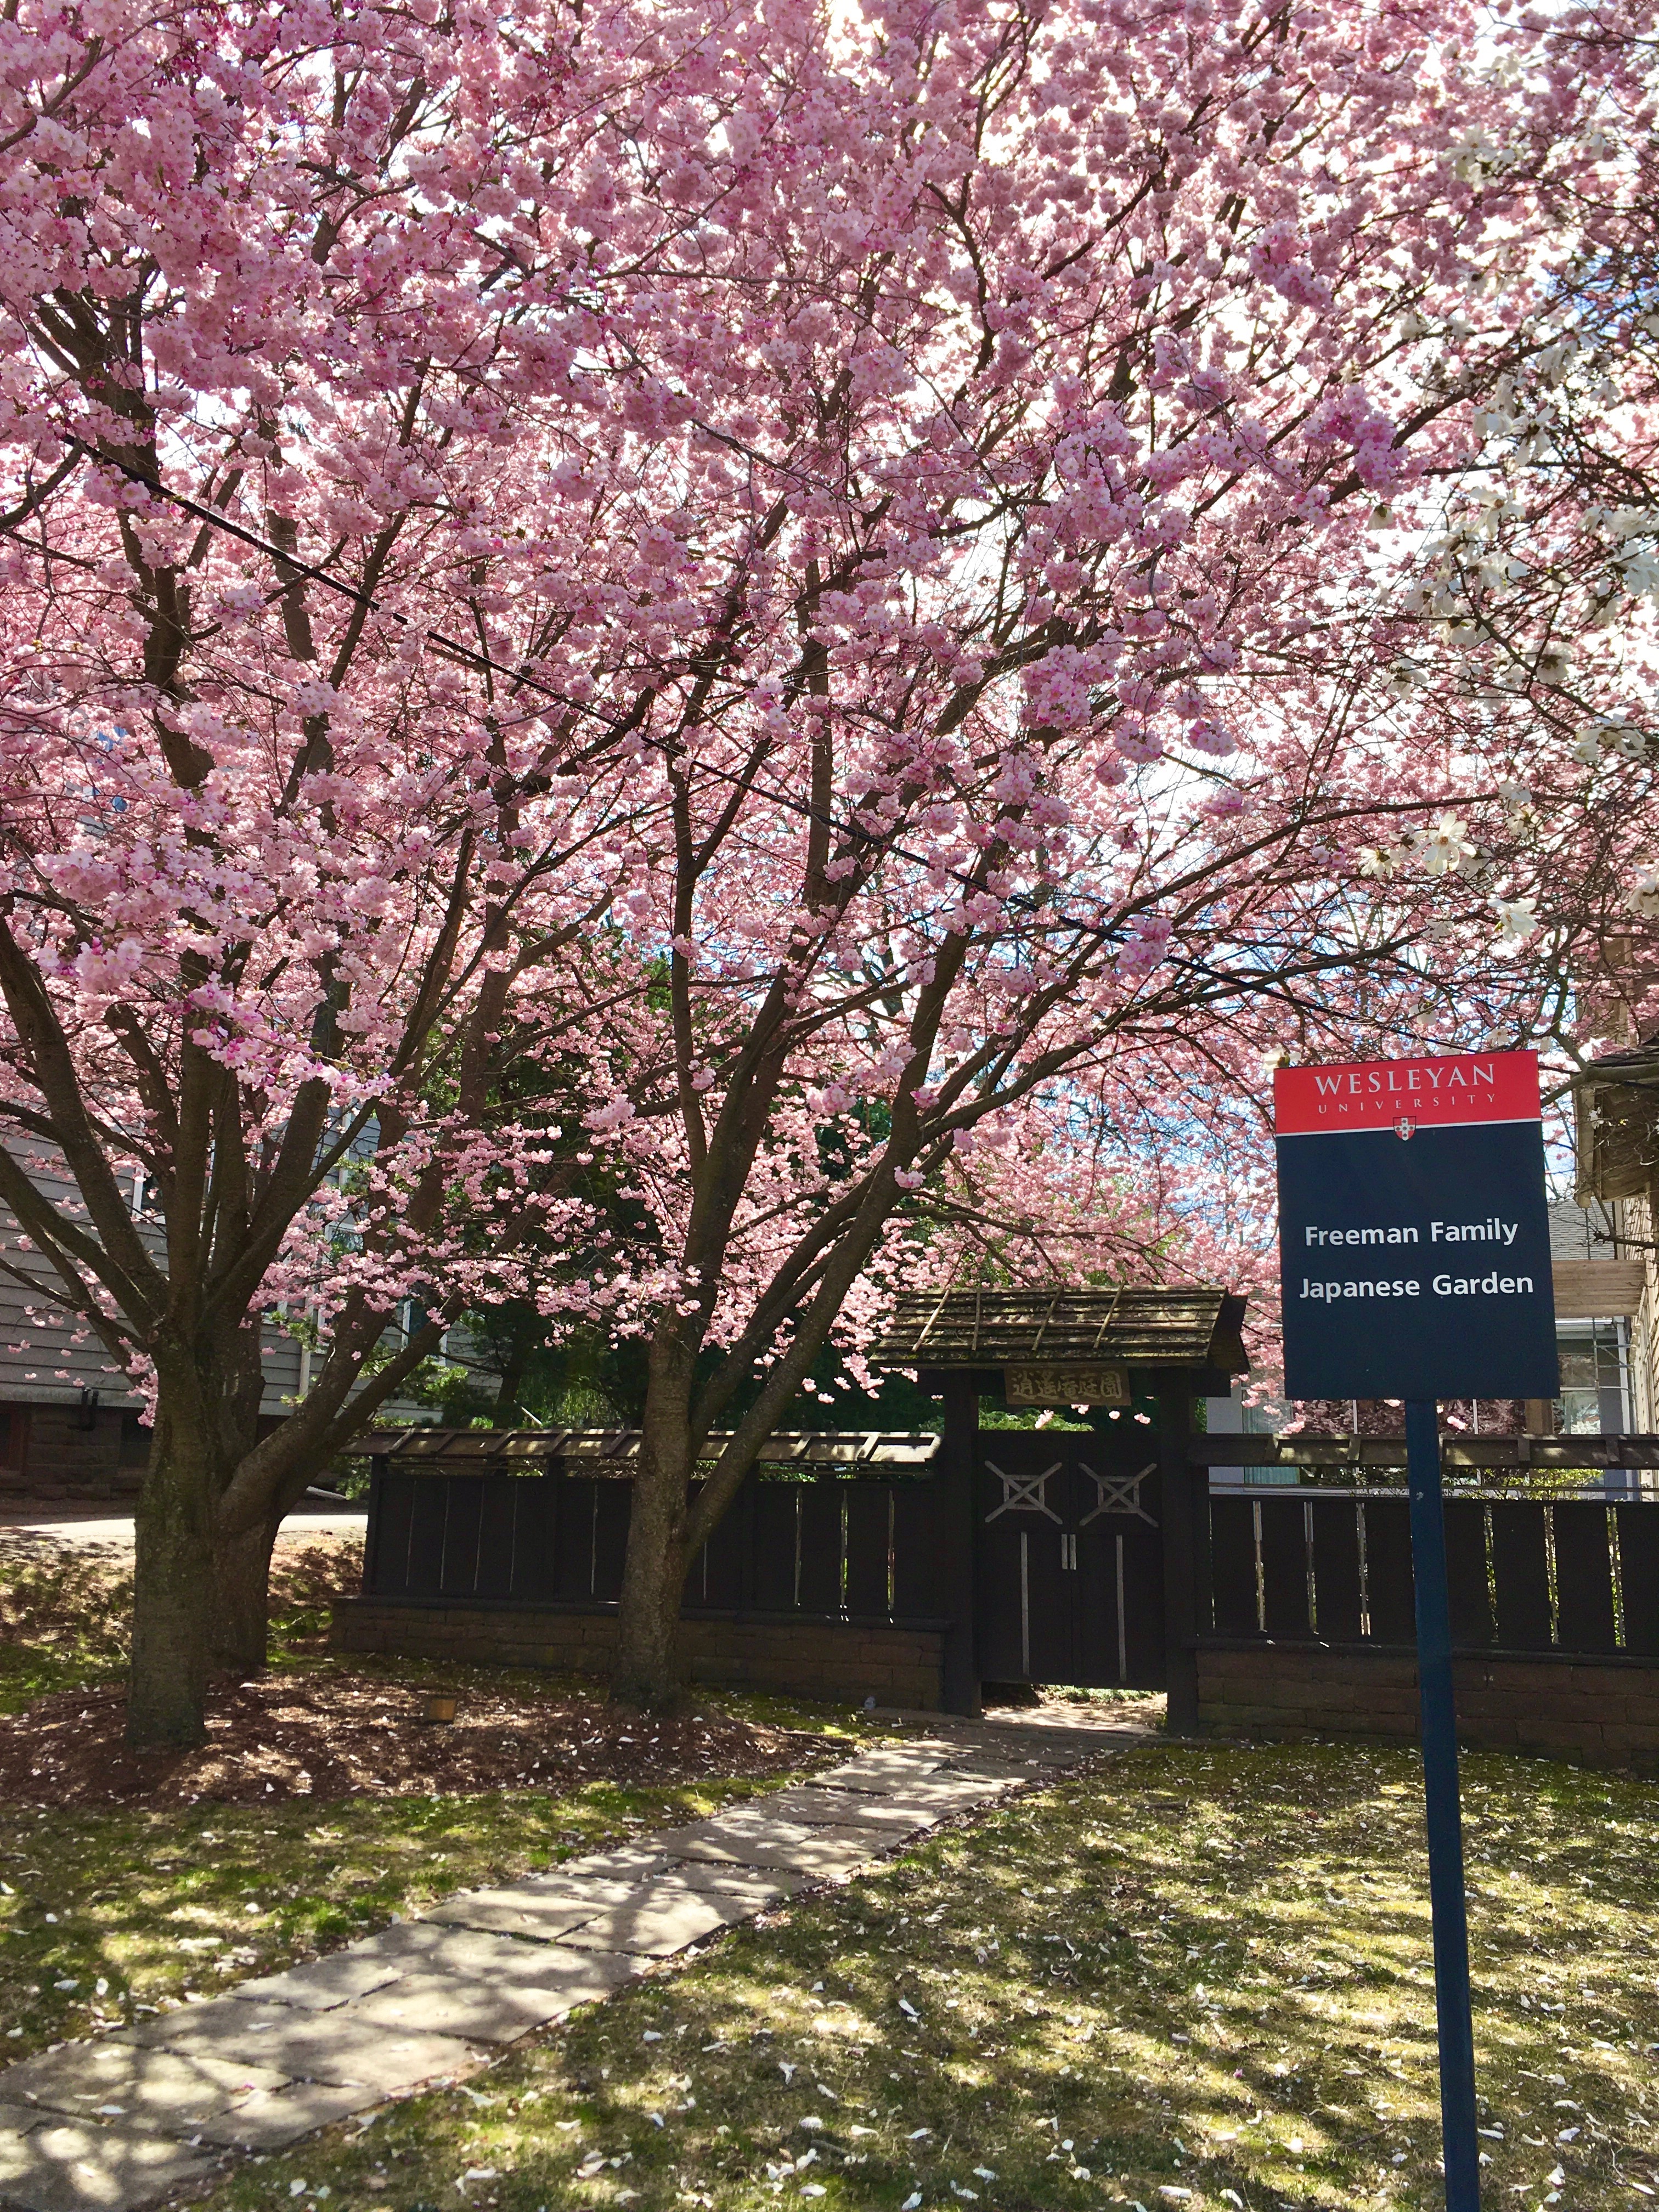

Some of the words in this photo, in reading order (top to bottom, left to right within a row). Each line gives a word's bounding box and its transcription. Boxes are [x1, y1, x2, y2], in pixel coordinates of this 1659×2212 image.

[1314, 1063, 1494, 1096] WESLEYAN
[1318, 1093, 1496, 1114] UNIVERSITY
[1305, 1226, 1419, 1246] Freeman
[1430, 1217, 1518, 1245] Family
[1299, 1278, 1420, 1304] Japanese
[1432, 1271, 1533, 1295] Garden
